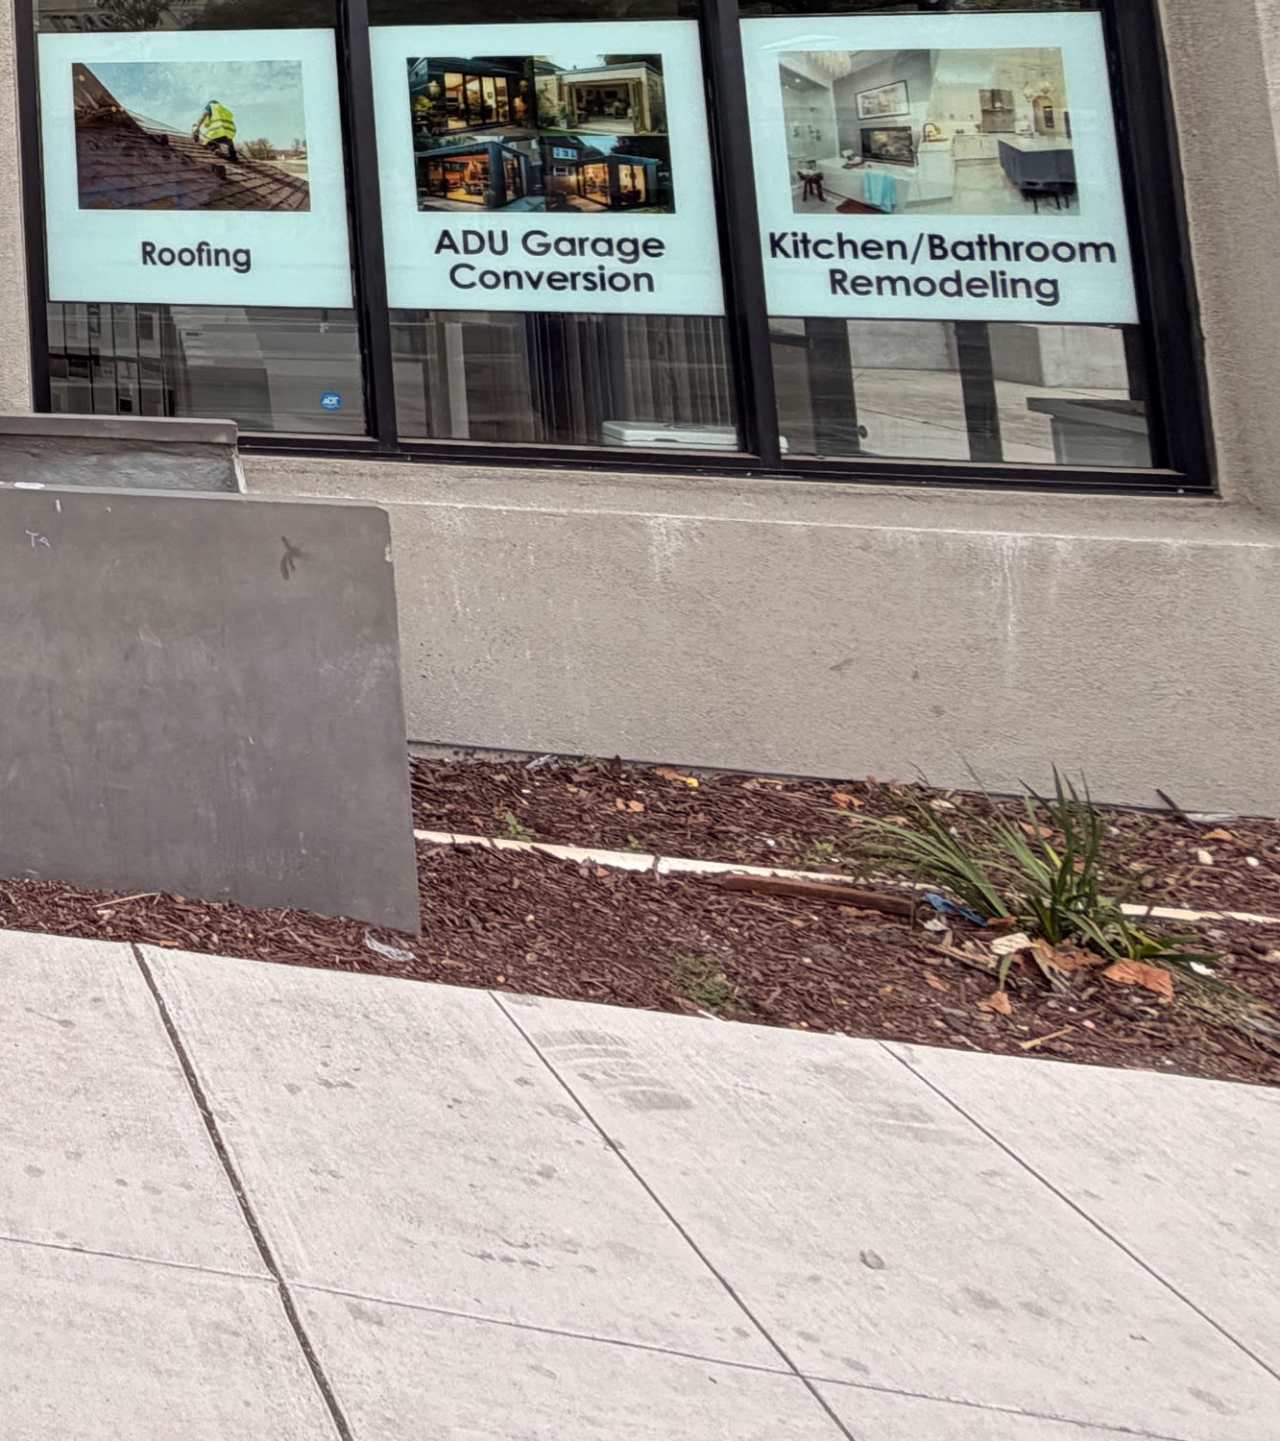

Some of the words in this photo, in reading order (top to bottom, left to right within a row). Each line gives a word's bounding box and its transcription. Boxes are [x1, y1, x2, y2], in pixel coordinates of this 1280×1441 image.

[142, 241, 251, 274] Roofing
[434, 229, 509, 256] ADU
[521, 229, 666, 264] Garage
[769, 232, 1117, 264] Kitchen/Bathroom
[449, 263, 655, 292] Conversion
[828, 268, 1060, 306] Remodeling
